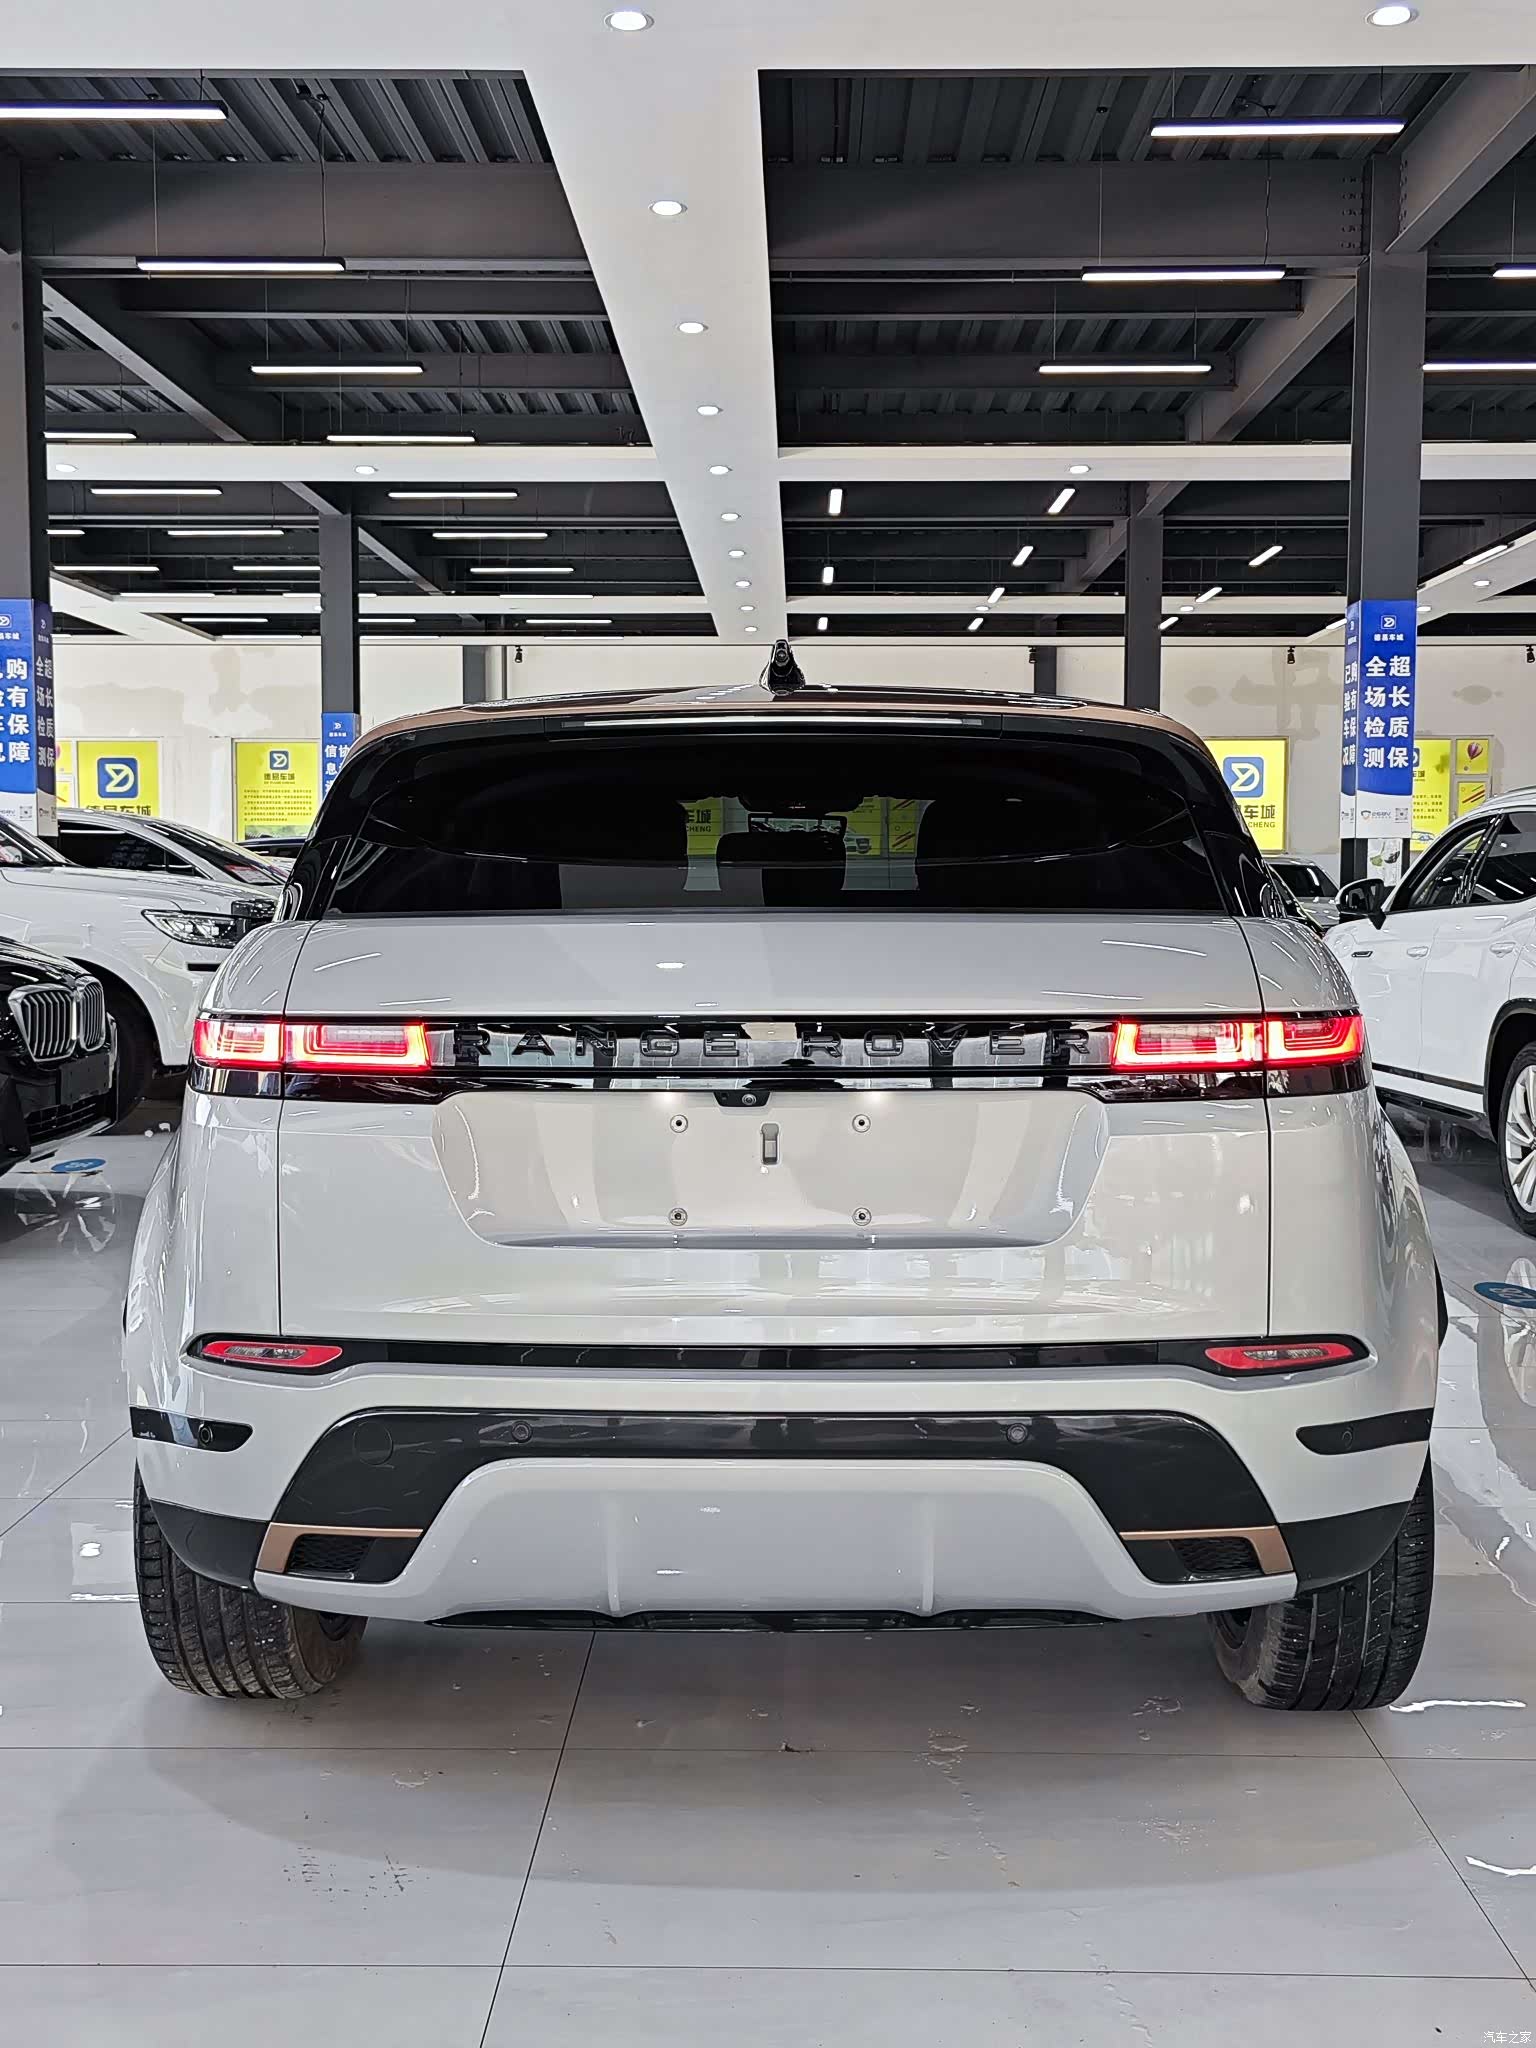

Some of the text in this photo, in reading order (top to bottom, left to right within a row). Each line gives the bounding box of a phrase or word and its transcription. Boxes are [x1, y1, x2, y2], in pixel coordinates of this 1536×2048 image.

[6, 657, 30, 763] 购有保障
[1363, 655, 1387, 769] 全场检测
[1387, 655, 1411, 769] 超长质保
[1236, 804, 1276, 820] 车城
[453, 1028, 1091, 1058] RANGE ROVER
